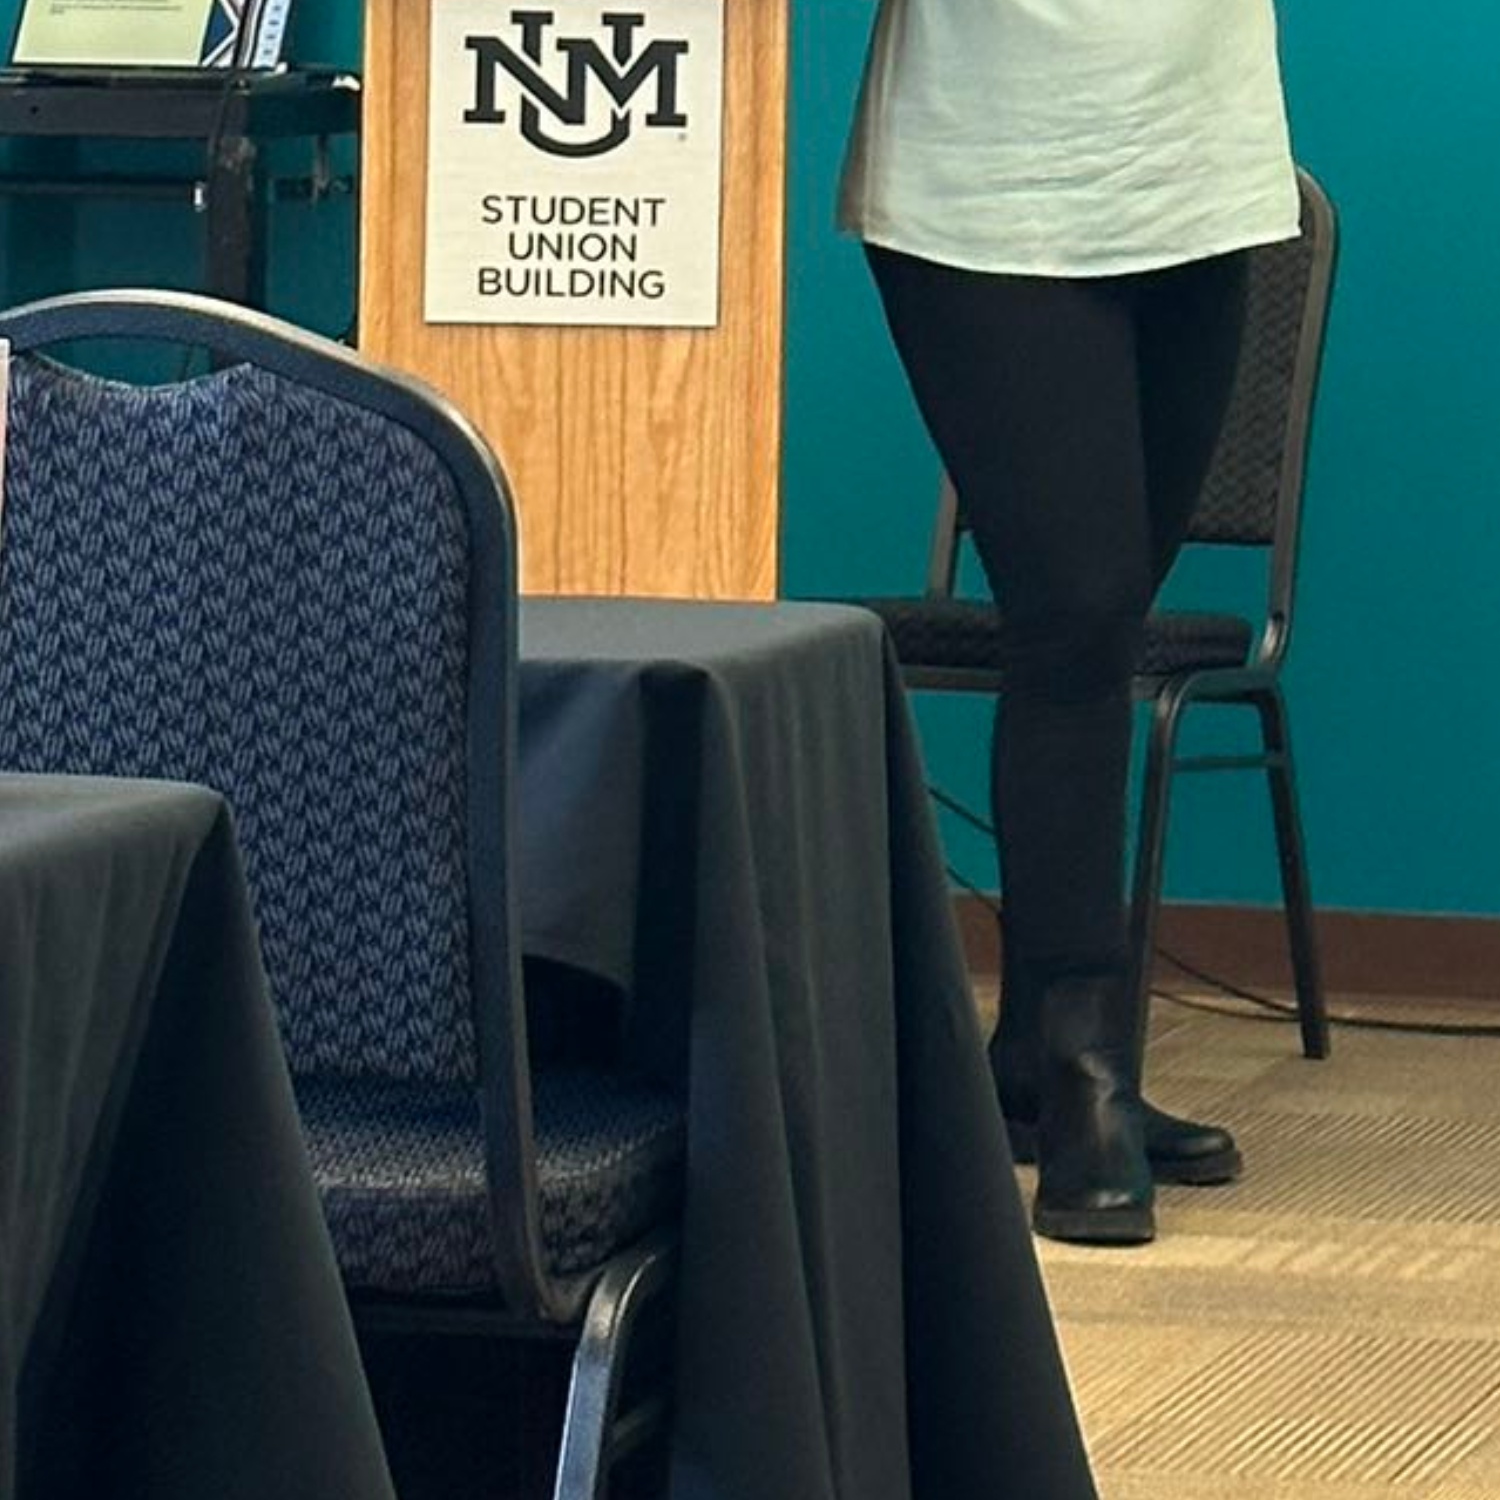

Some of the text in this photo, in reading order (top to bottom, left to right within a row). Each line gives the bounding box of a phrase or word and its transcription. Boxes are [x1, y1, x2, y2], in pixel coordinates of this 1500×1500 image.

[481, 194, 666, 226] STUDENT
[508, 232, 637, 262] UNION
[478, 267, 666, 299] BUILDING
